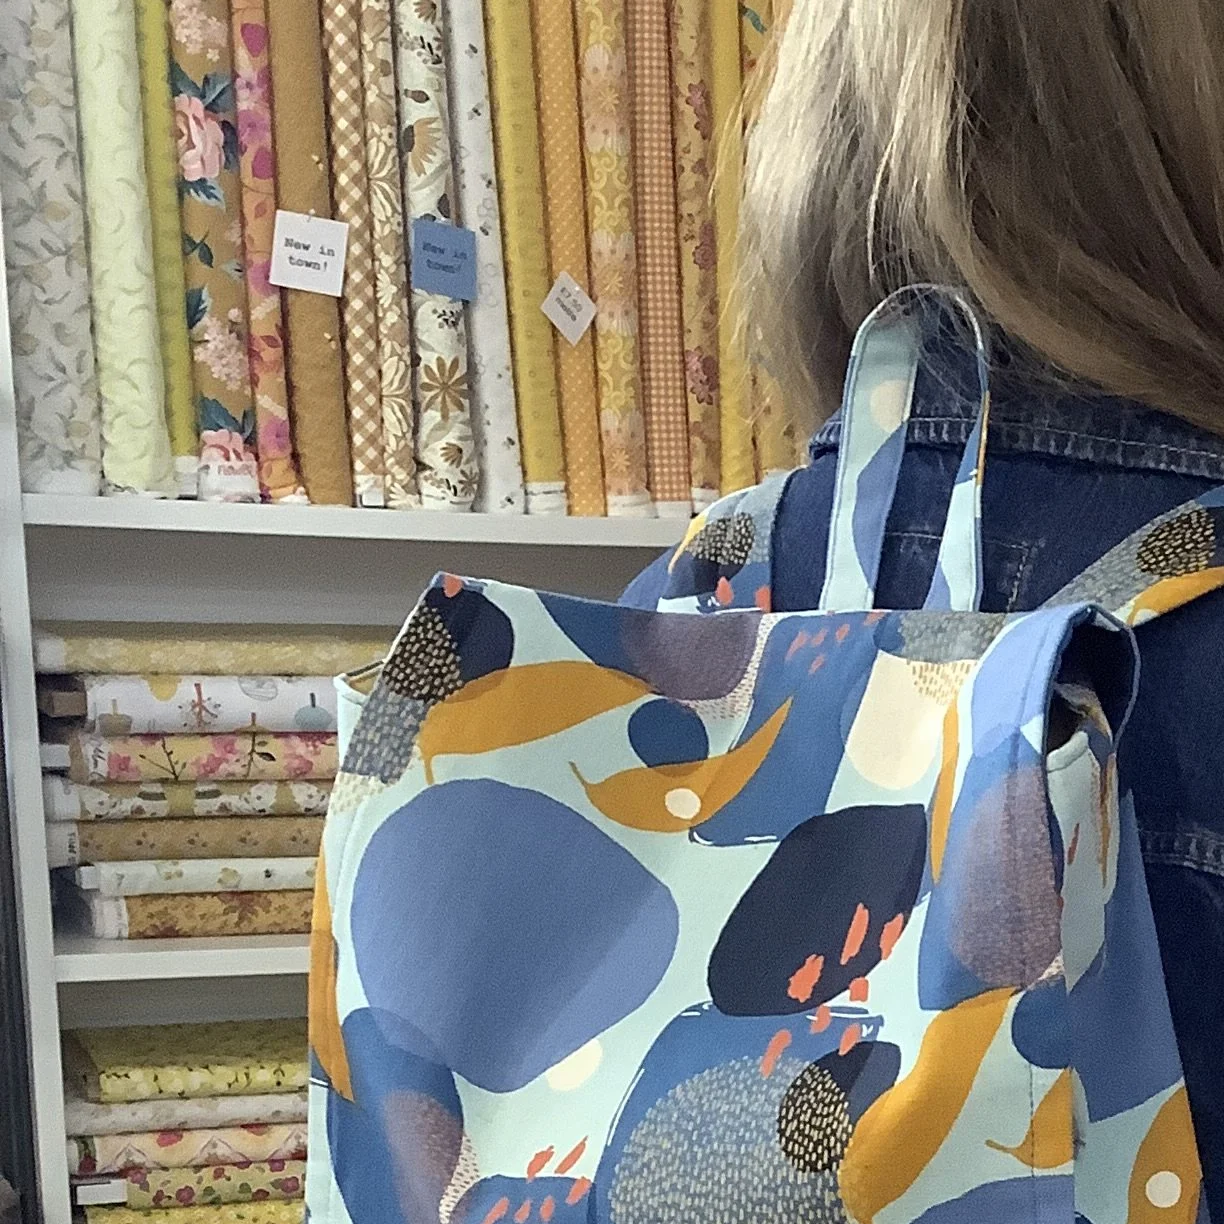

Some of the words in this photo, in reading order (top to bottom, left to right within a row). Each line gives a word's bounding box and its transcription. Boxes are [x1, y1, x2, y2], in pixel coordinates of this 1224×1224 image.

[284, 237, 311, 251] New
[319, 245, 335, 257] in
[423, 242, 445, 255] New
[452, 249, 468, 260] in
[288, 255, 328, 272] town!
